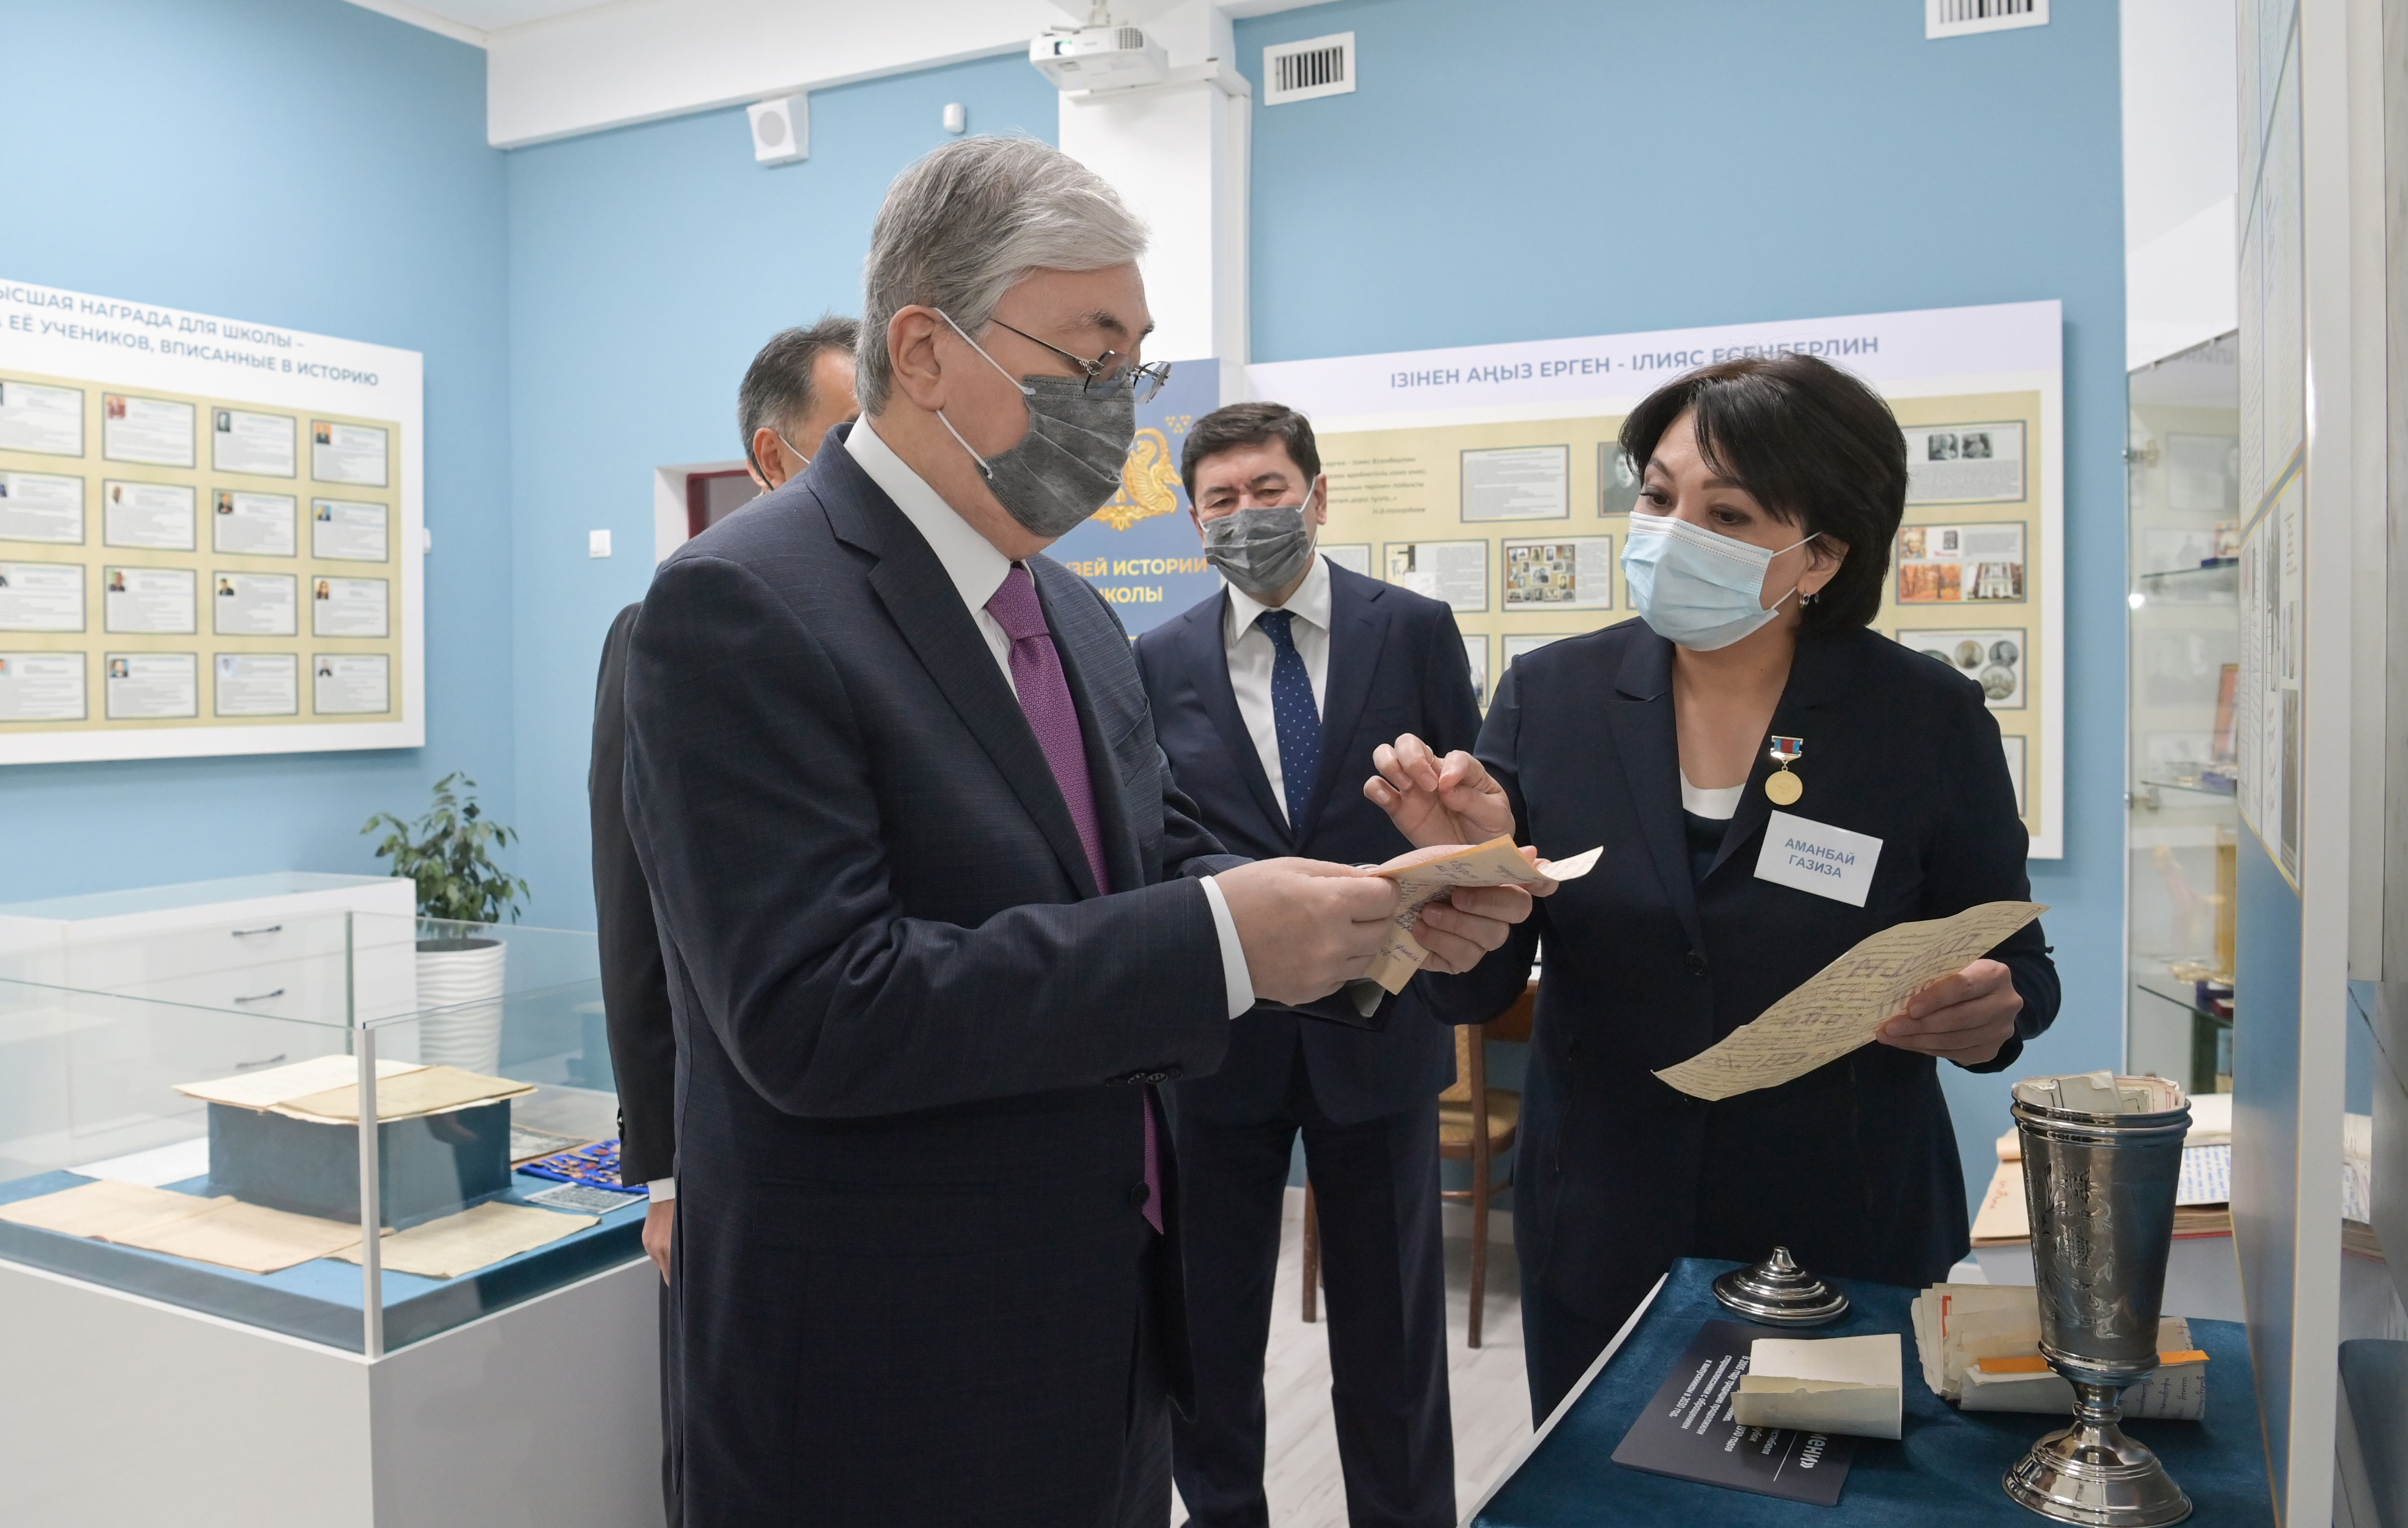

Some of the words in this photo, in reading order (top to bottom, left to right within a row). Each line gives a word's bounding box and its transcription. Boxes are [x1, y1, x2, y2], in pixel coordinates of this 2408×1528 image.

[0, 287, 73, 311] ЫСШАЯ
[80, 300, 173, 328] НАГРАДА
[178, 317, 217, 335] ДЛЯ
[223, 324, 292, 348] ШКОЛЫ
[9, 313, 34, 332] ЕЁ
[41, 319, 154, 353] УЧЕНИКОВ,
[160, 339, 277, 372] ВПИСАННЫЕ
[281, 359, 293, 373] В
[297, 362, 380, 386] ИСТОРИЮ
[1391, 368, 1460, 388] ІЗІНЕН
[1467, 363, 1533, 384] АҢЫЗ
[1540, 357, 1611, 378] ЕРГЕН
[1633, 350, 1704, 371] ІЛИЯС
[1066, 557, 1108, 577] ЗЕЙ
[1113, 557, 1208, 576] ИСТОРИИ
[1099, 586, 1163, 603] КОЛЫ
[1785, 838, 1855, 865] АМАНБАЙ
[1789, 854, 1842, 878] ГАЗИЗА
[1703, 1355, 1732, 1395] старшеклассники
[1728, 1370, 1741, 1381] году
[1735, 1359, 1748, 1371] 2005
[1686, 1363, 1711, 1393] выпускникам
[1676, 1396, 1691, 1408] 2030
[1715, 1380, 1734, 1404] традицию
[1681, 1398, 1706, 1430] обращением
[1696, 1403, 1721, 1435] продолжили
[1725, 1436, 1738, 1452] годов
[1749, 1427, 1762, 1442] убок
